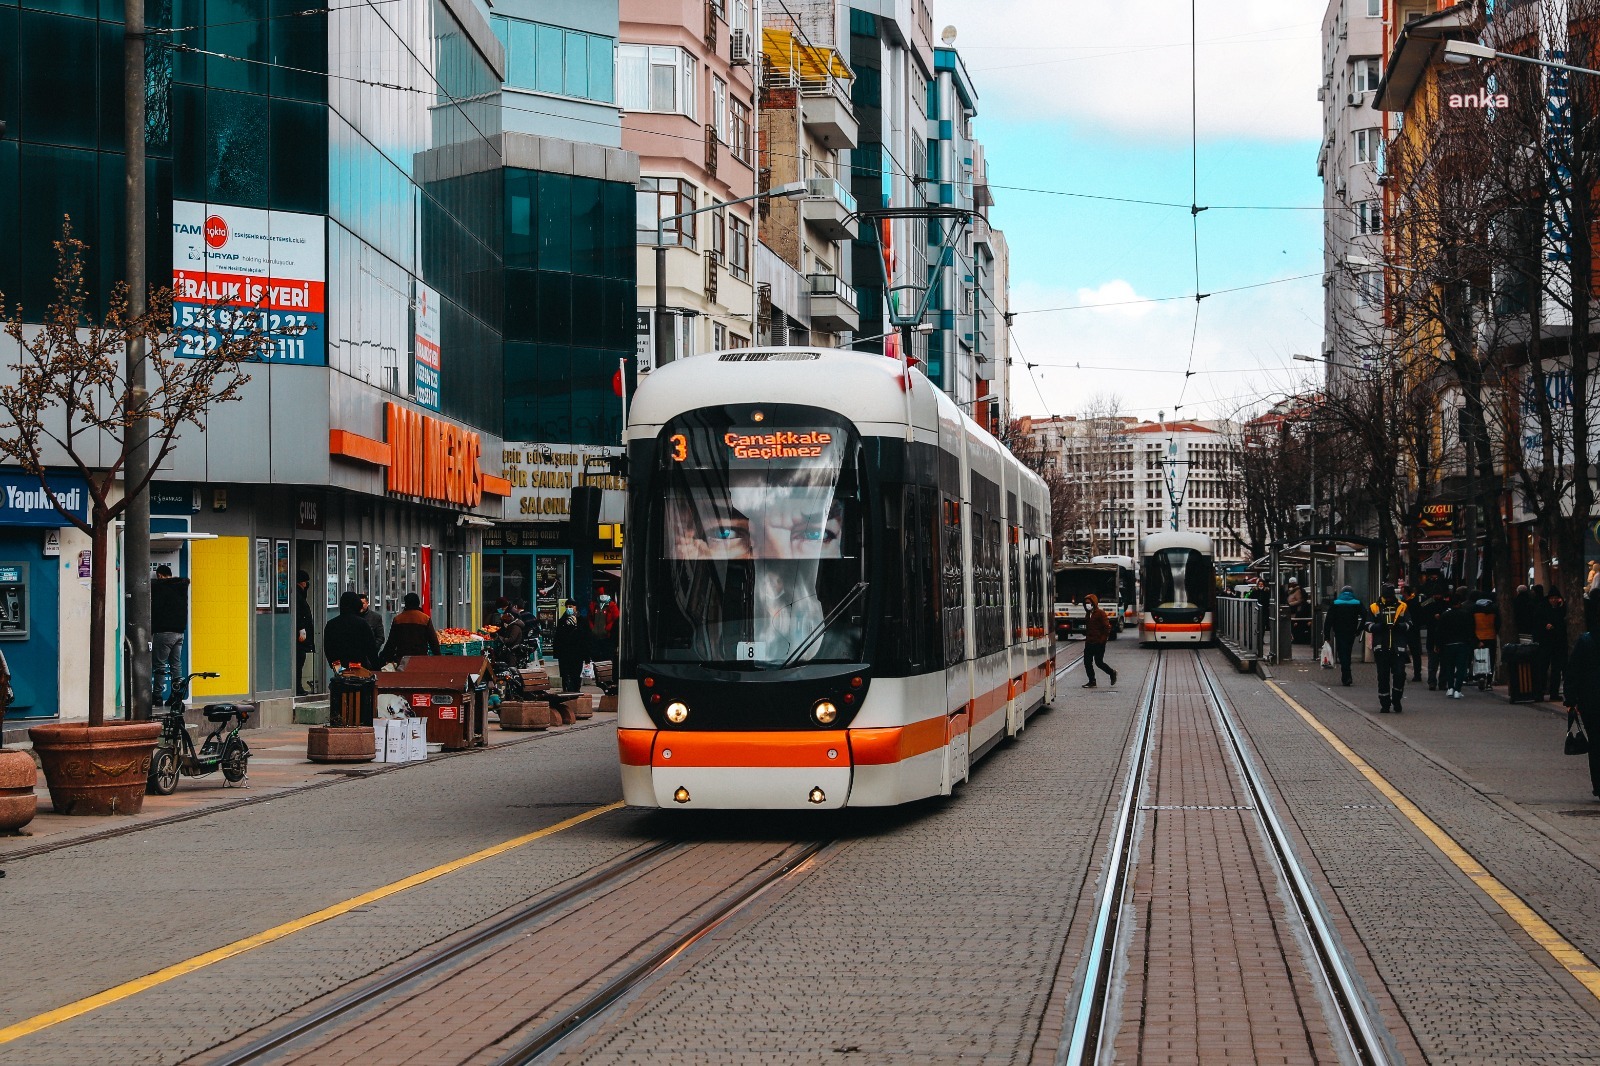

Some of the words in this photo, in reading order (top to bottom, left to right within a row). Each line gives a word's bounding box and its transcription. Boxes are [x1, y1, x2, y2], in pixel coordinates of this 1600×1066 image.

[173, 223, 202, 236] TAM
[206, 225, 226, 238] nokta
[202, 251, 240, 261] TURYAP
[242, 256, 262, 264] holding
[245, 277, 262, 309] İŞ
[266, 281, 309, 308] YERİ
[278, 338, 305, 360] 111
[670, 434, 688, 462] 3
[724, 430, 832, 448] Çanakkale
[734, 444, 822, 460] Geçilmez
[527, 449, 579, 468] BÜYKŞEHİR
[532, 469, 573, 489] SANAT
[300, 501, 317, 526] ÇIKIŞ
[520, 496, 571, 515] SALONL
[747, 646, 755, 658] 8
